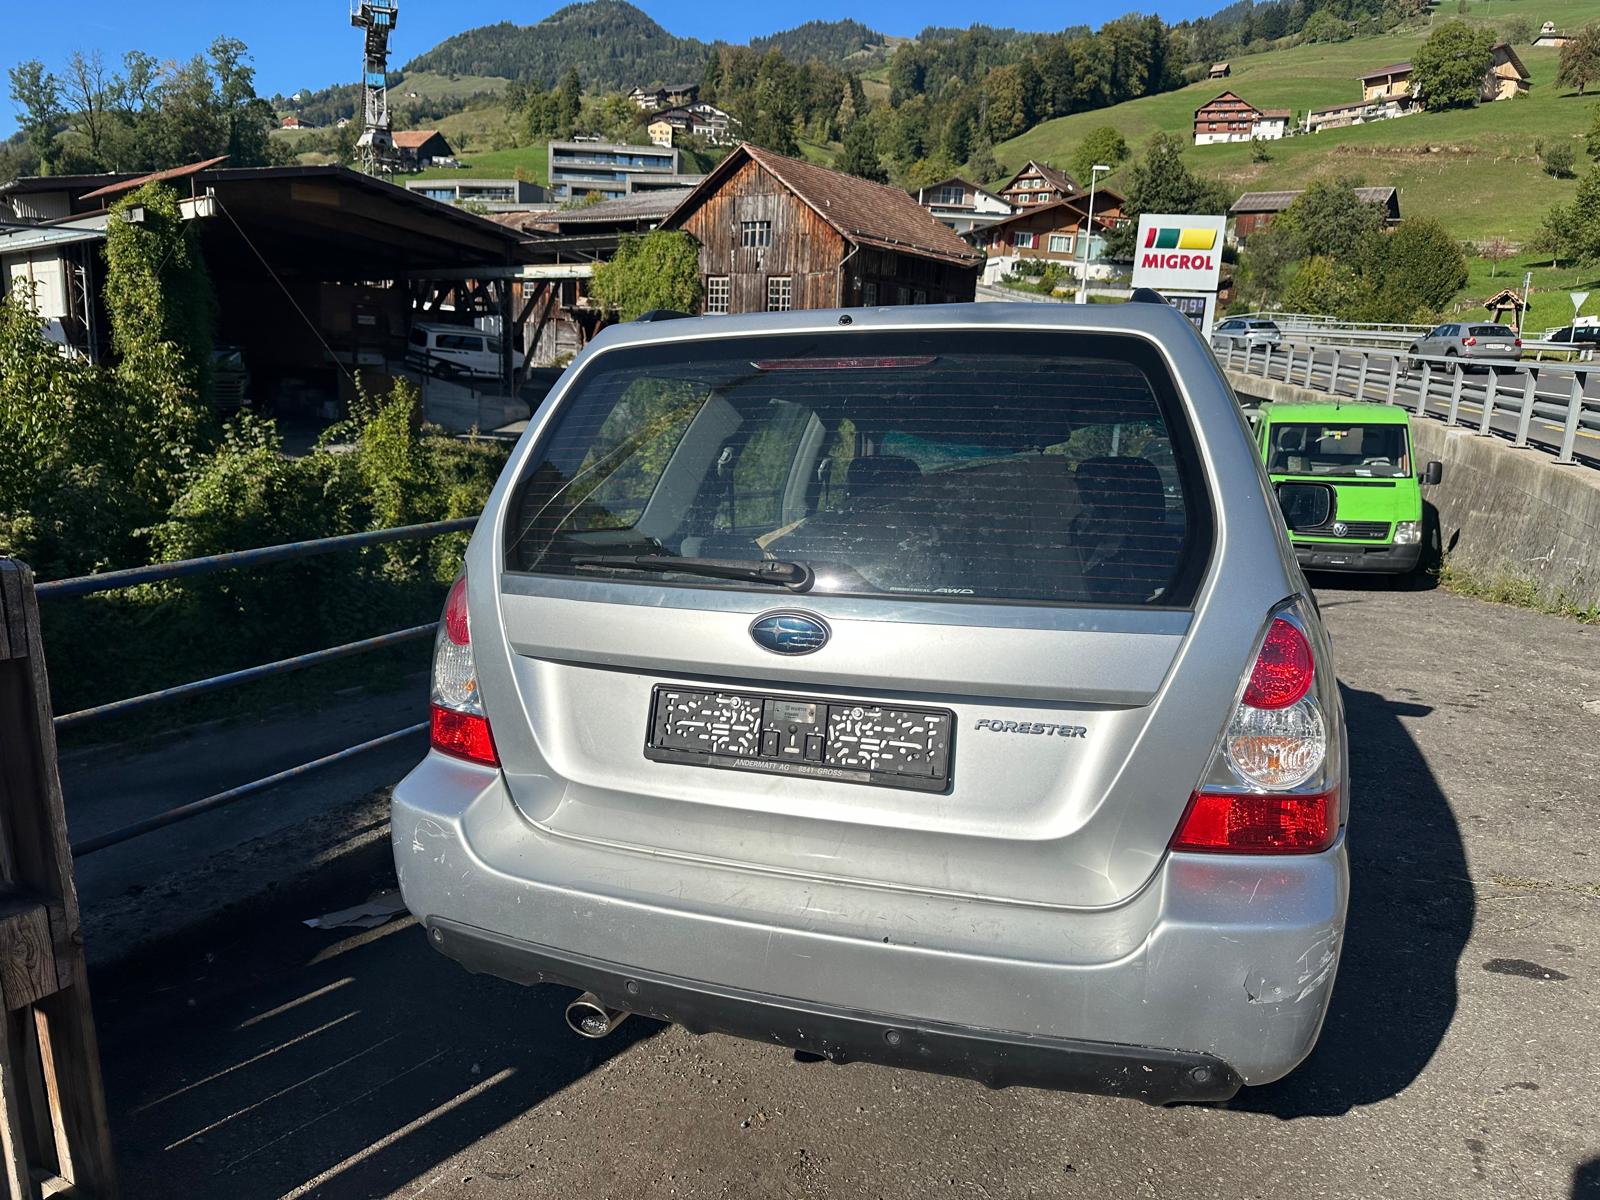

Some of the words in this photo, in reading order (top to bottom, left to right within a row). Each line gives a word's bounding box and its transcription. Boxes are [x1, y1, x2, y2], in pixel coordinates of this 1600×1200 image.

[1141, 254, 1214, 270] MIGROL
[932, 587, 975, 595] AWD
[974, 718, 1088, 739] FORESTER
[733, 758, 776, 769] ANDERMATT
[778, 763, 790, 771] AG
[817, 767, 843, 777] GROSS
